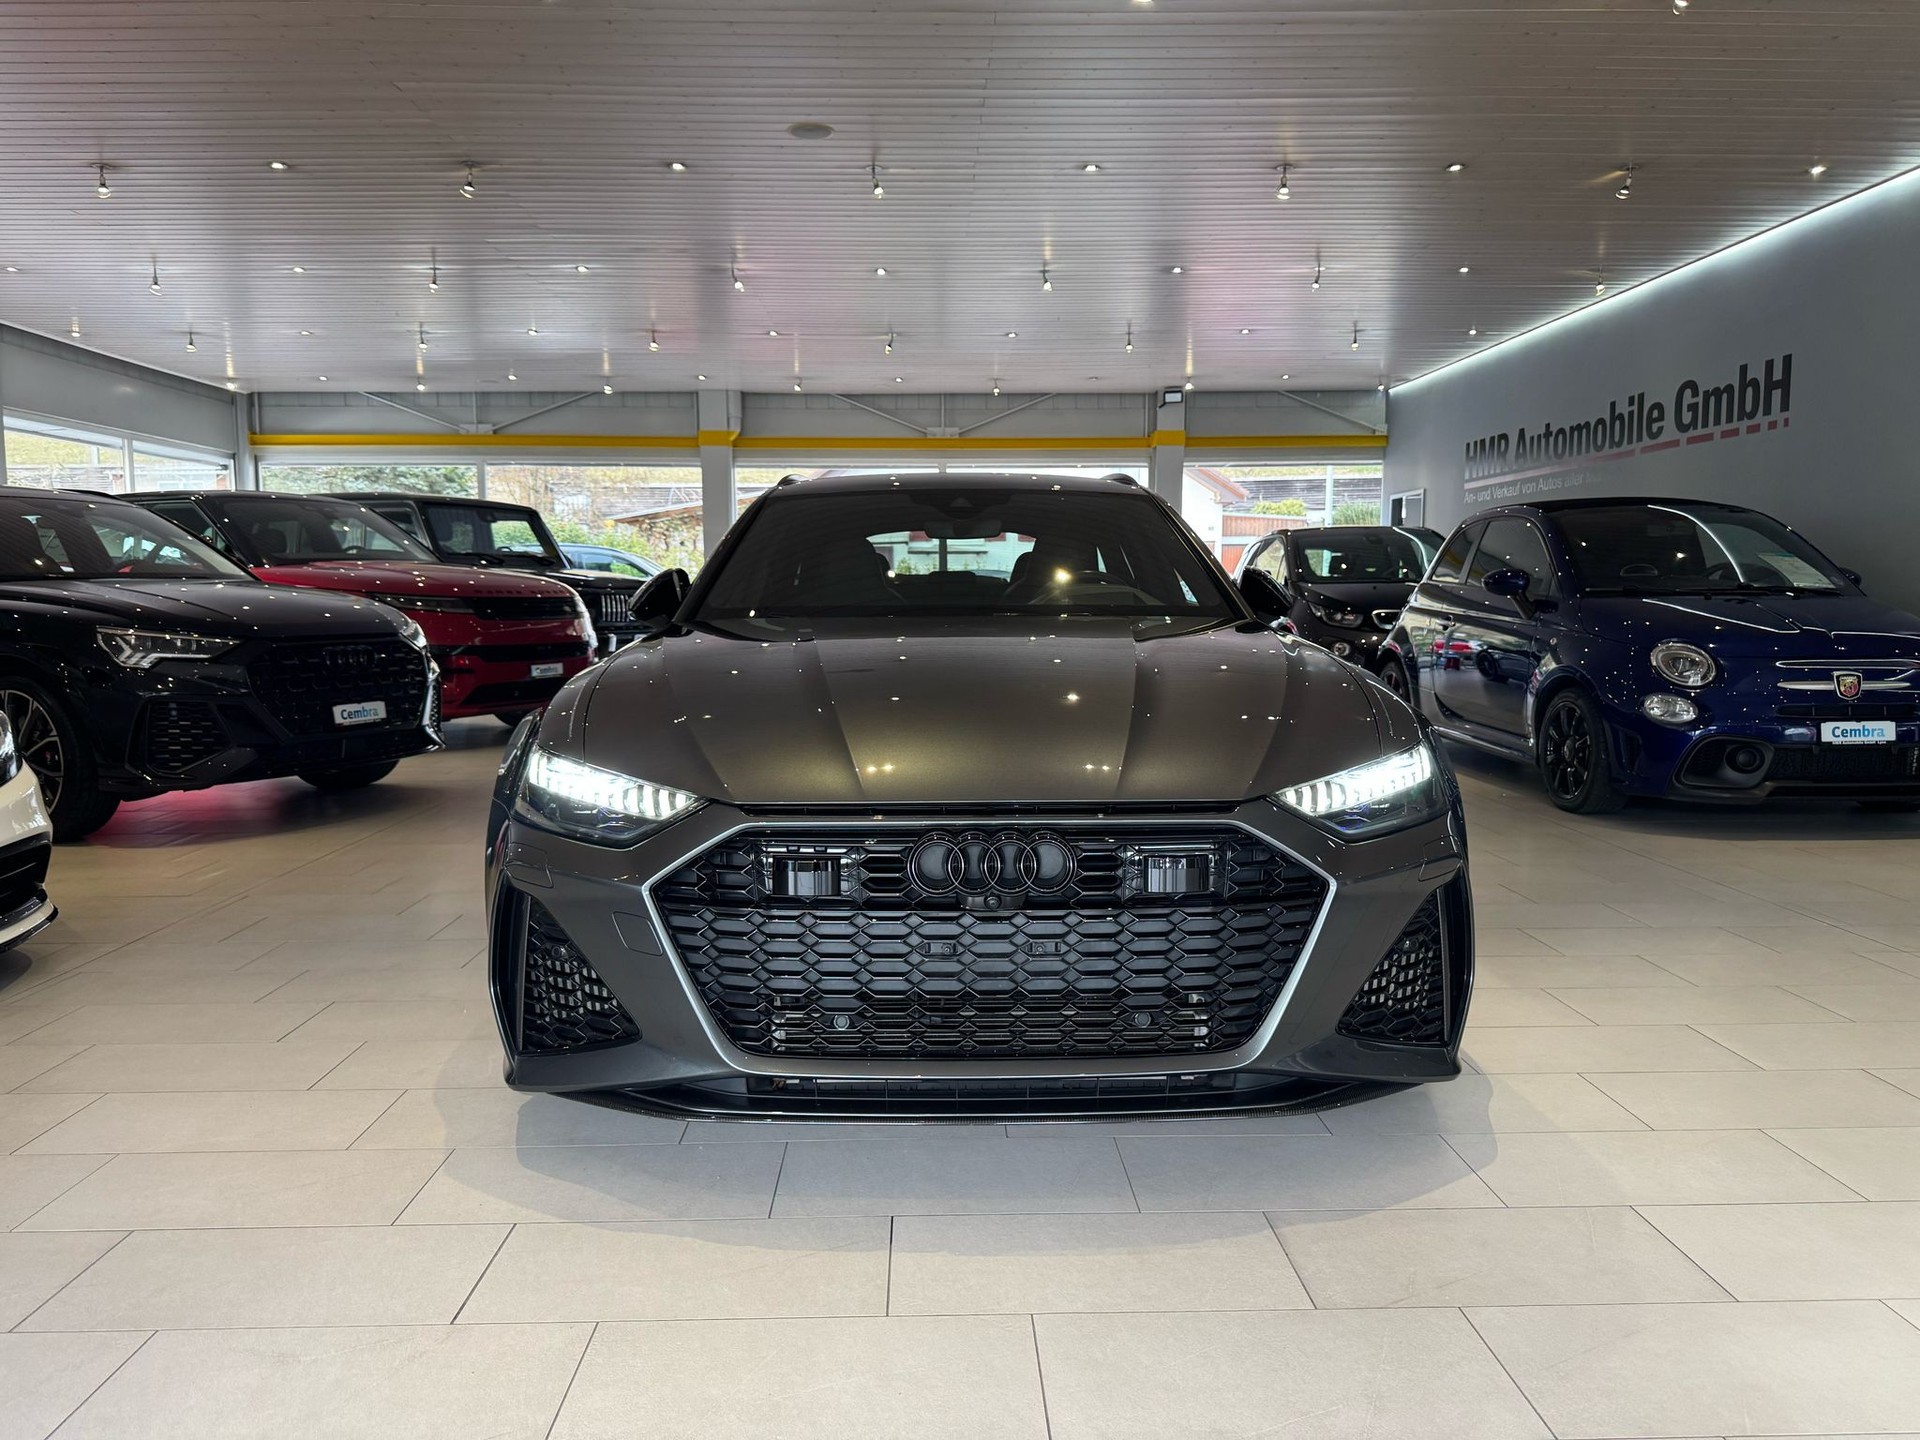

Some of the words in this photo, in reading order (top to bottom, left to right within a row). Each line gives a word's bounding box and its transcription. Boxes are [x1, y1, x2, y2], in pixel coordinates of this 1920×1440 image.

[1464, 432, 1510, 480] HMR
[1514, 392, 1665, 467] Automobile
[1674, 353, 1793, 434] GmbH
[1477, 487, 1491, 501] und
[1492, 481, 1521, 499] Verkauf
[1521, 483, 1537, 494] von
[1537, 477, 1563, 491] Autos
[1564, 471, 1585, 487] aller
[340, 706, 379, 720] Cembra
[1831, 725, 1885, 738] Cembra
